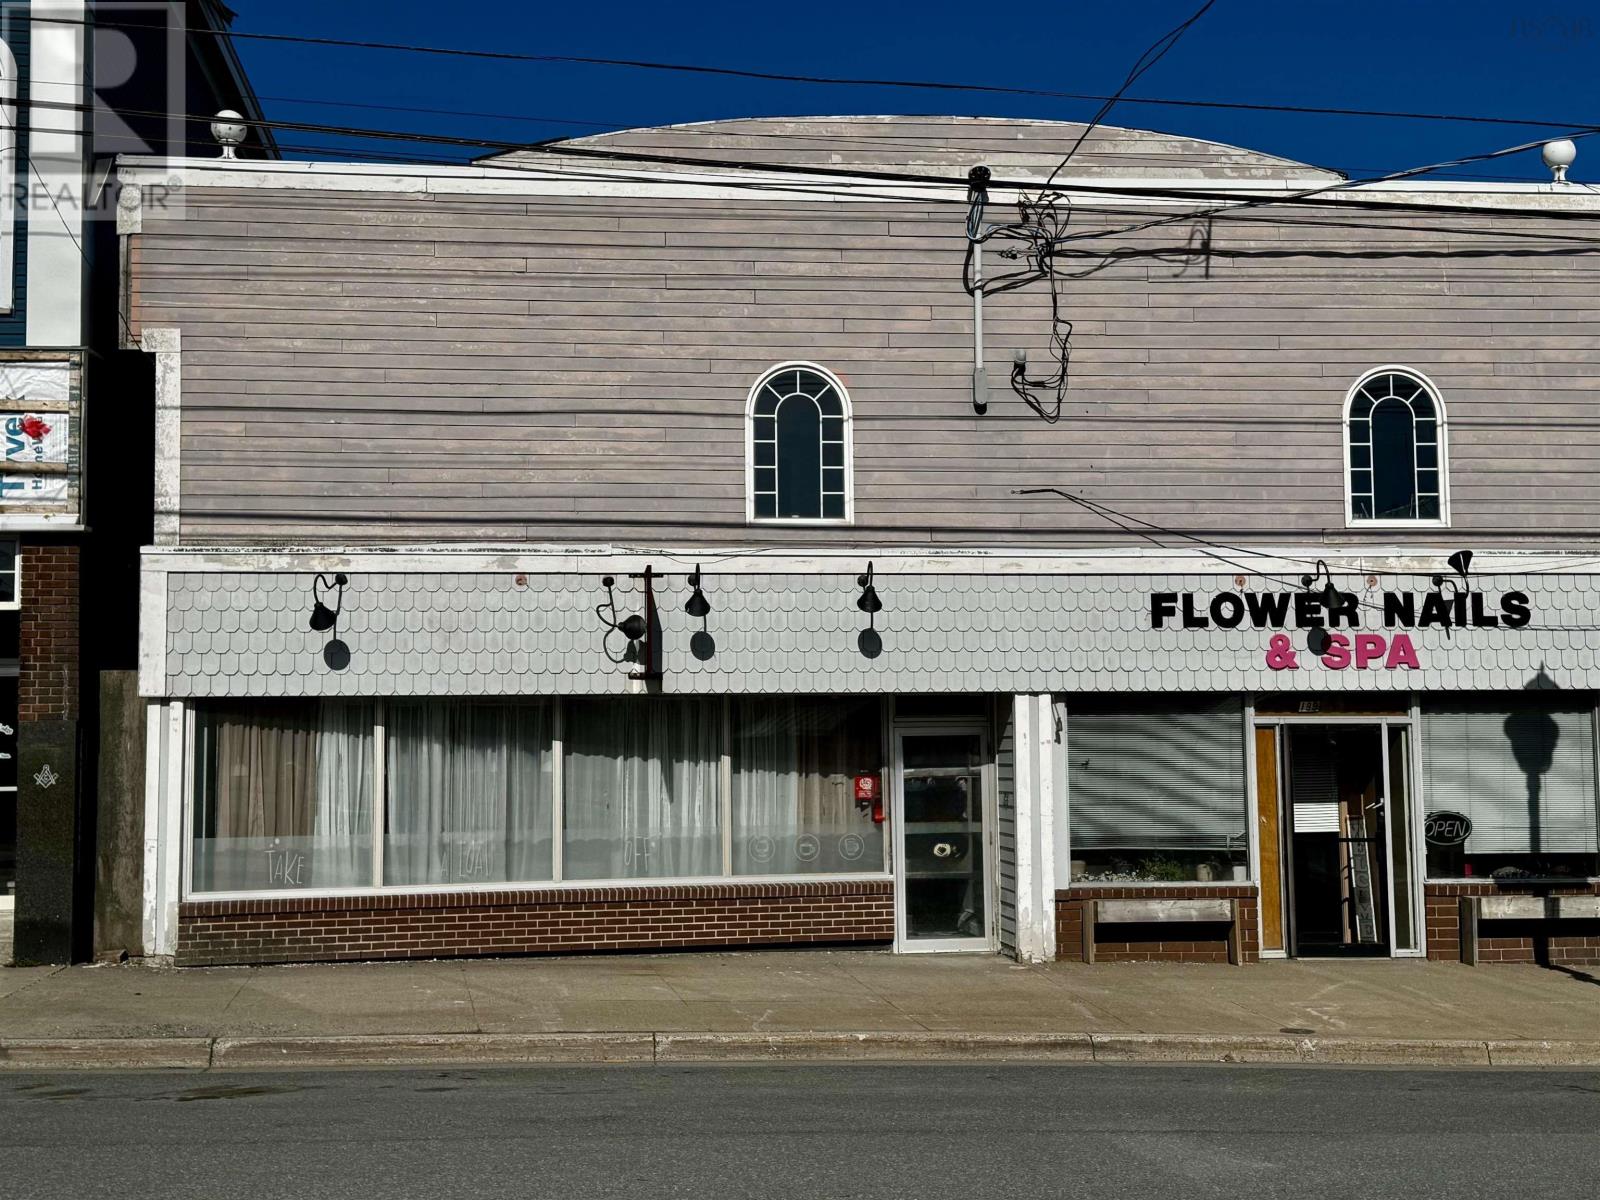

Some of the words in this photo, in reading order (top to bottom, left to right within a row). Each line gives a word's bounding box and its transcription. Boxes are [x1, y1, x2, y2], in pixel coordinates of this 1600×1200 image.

[1150, 591, 1360, 629] FLOWER
[1383, 590, 1532, 629] NAILS
[1265, 633, 1300, 671] &
[1320, 633, 1421, 671] SPA
[1425, 820, 1467, 837] OPEN
[263, 849, 305, 884] TAKE
[623, 836, 653, 873] OFF
